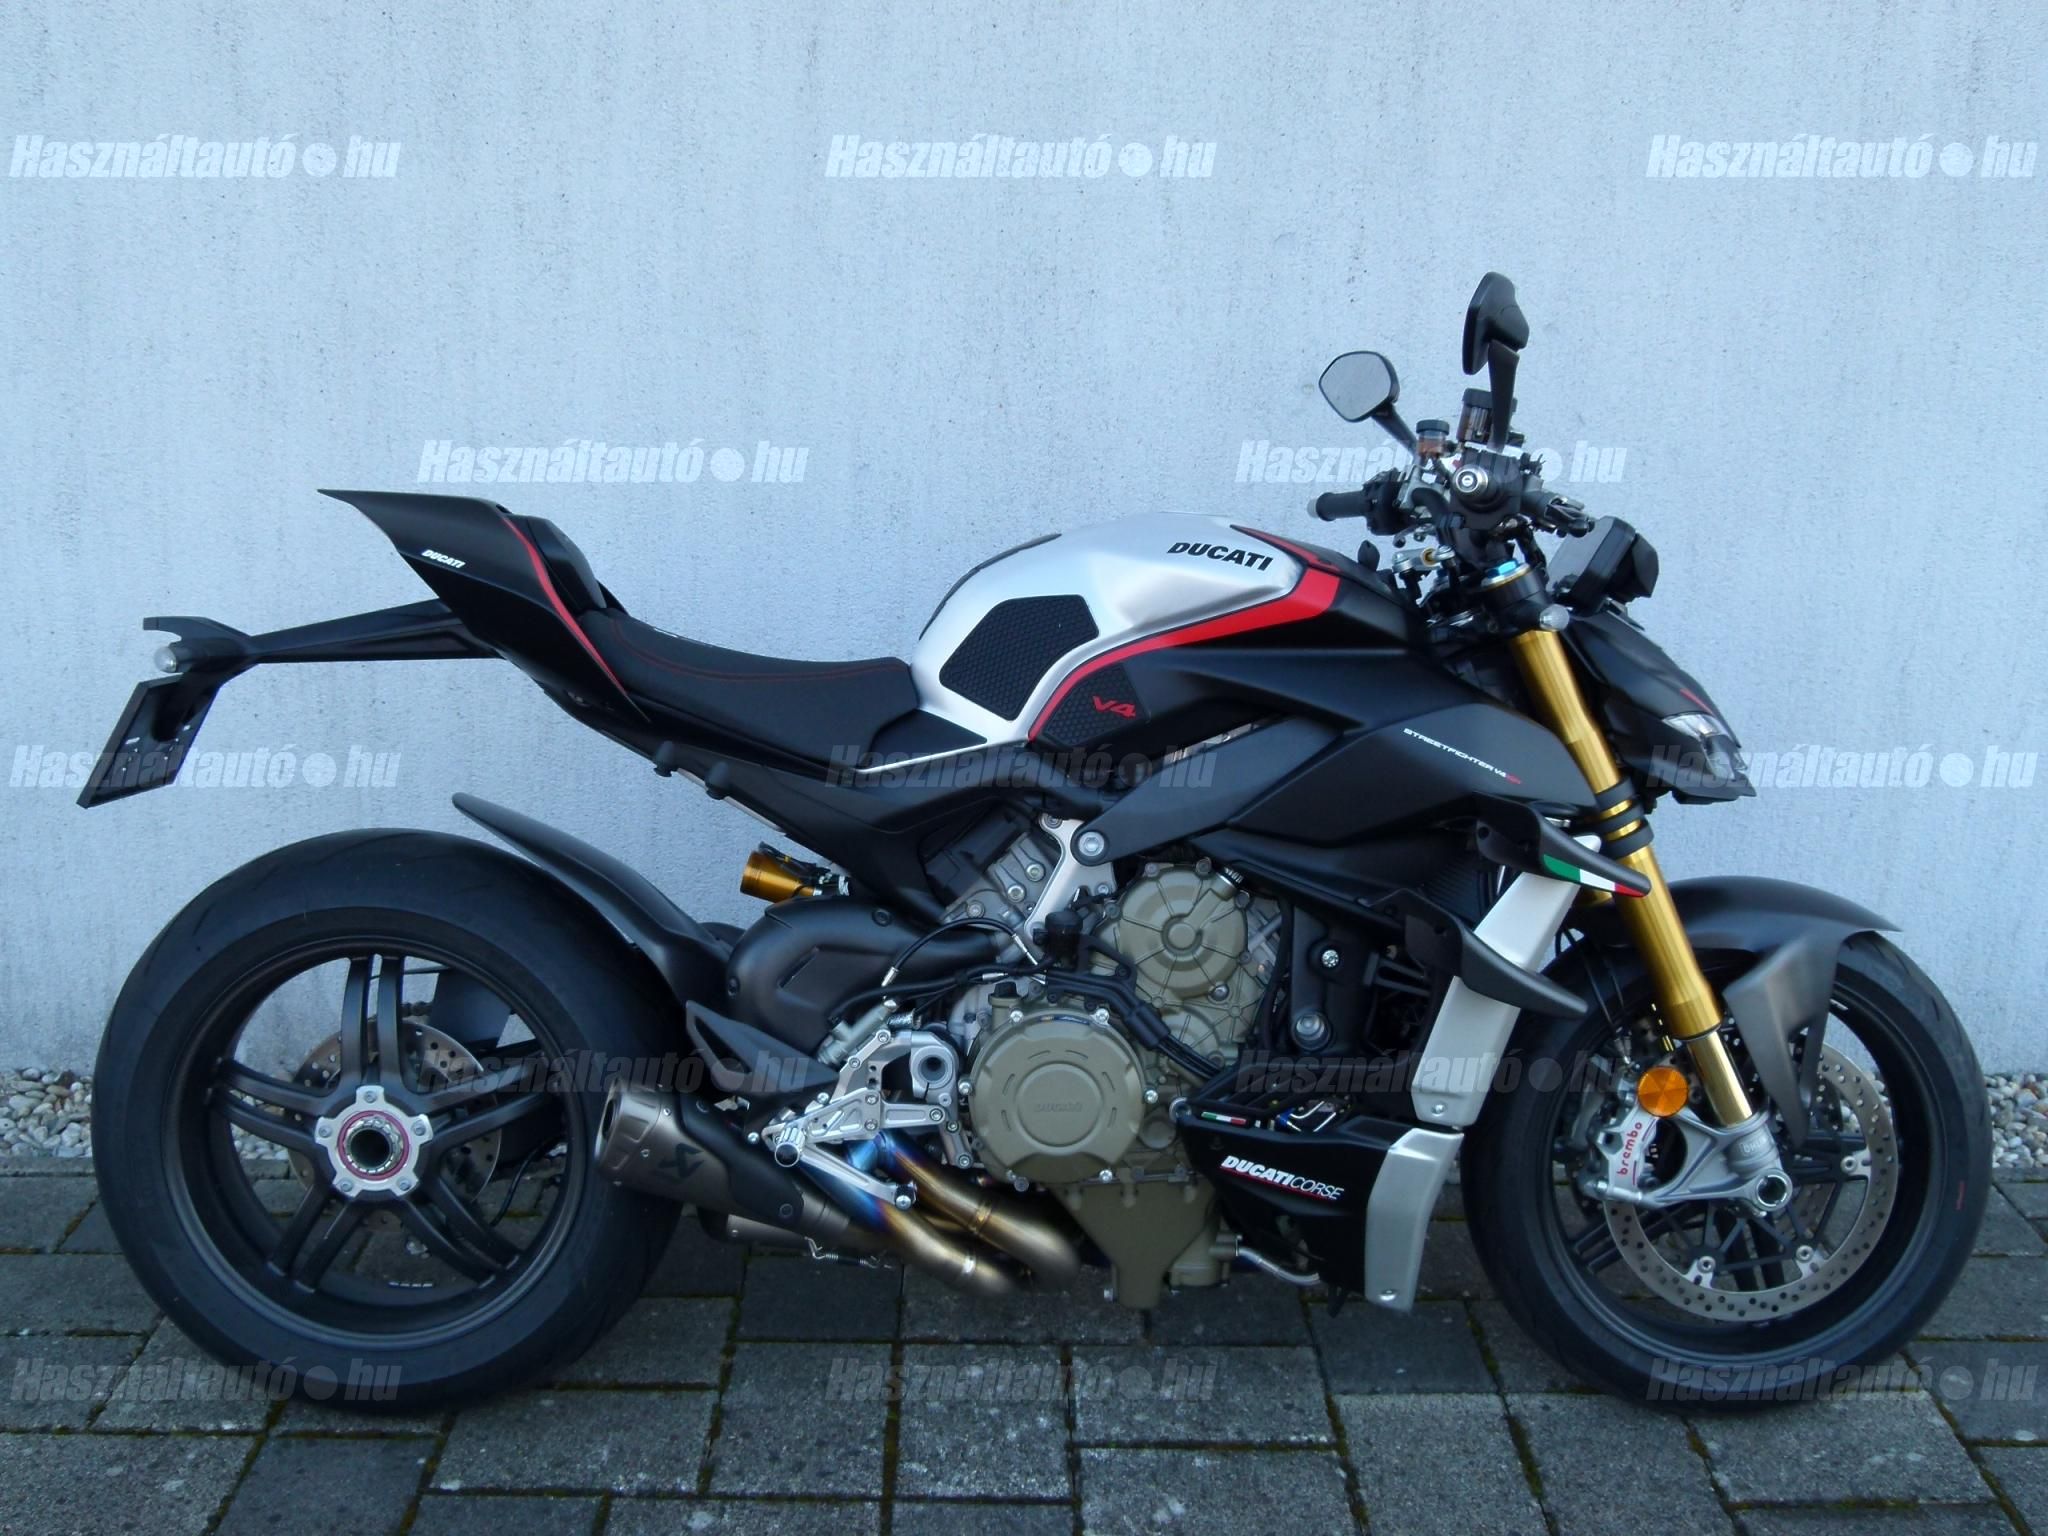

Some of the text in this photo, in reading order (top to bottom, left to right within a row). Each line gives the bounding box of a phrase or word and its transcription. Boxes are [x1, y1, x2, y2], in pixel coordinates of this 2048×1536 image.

[421, 548, 467, 569] DUCATI
[1166, 542, 1274, 572] DUCATI
[1092, 695, 1137, 717] V4
[1616, 1121, 1643, 1176] brembo
